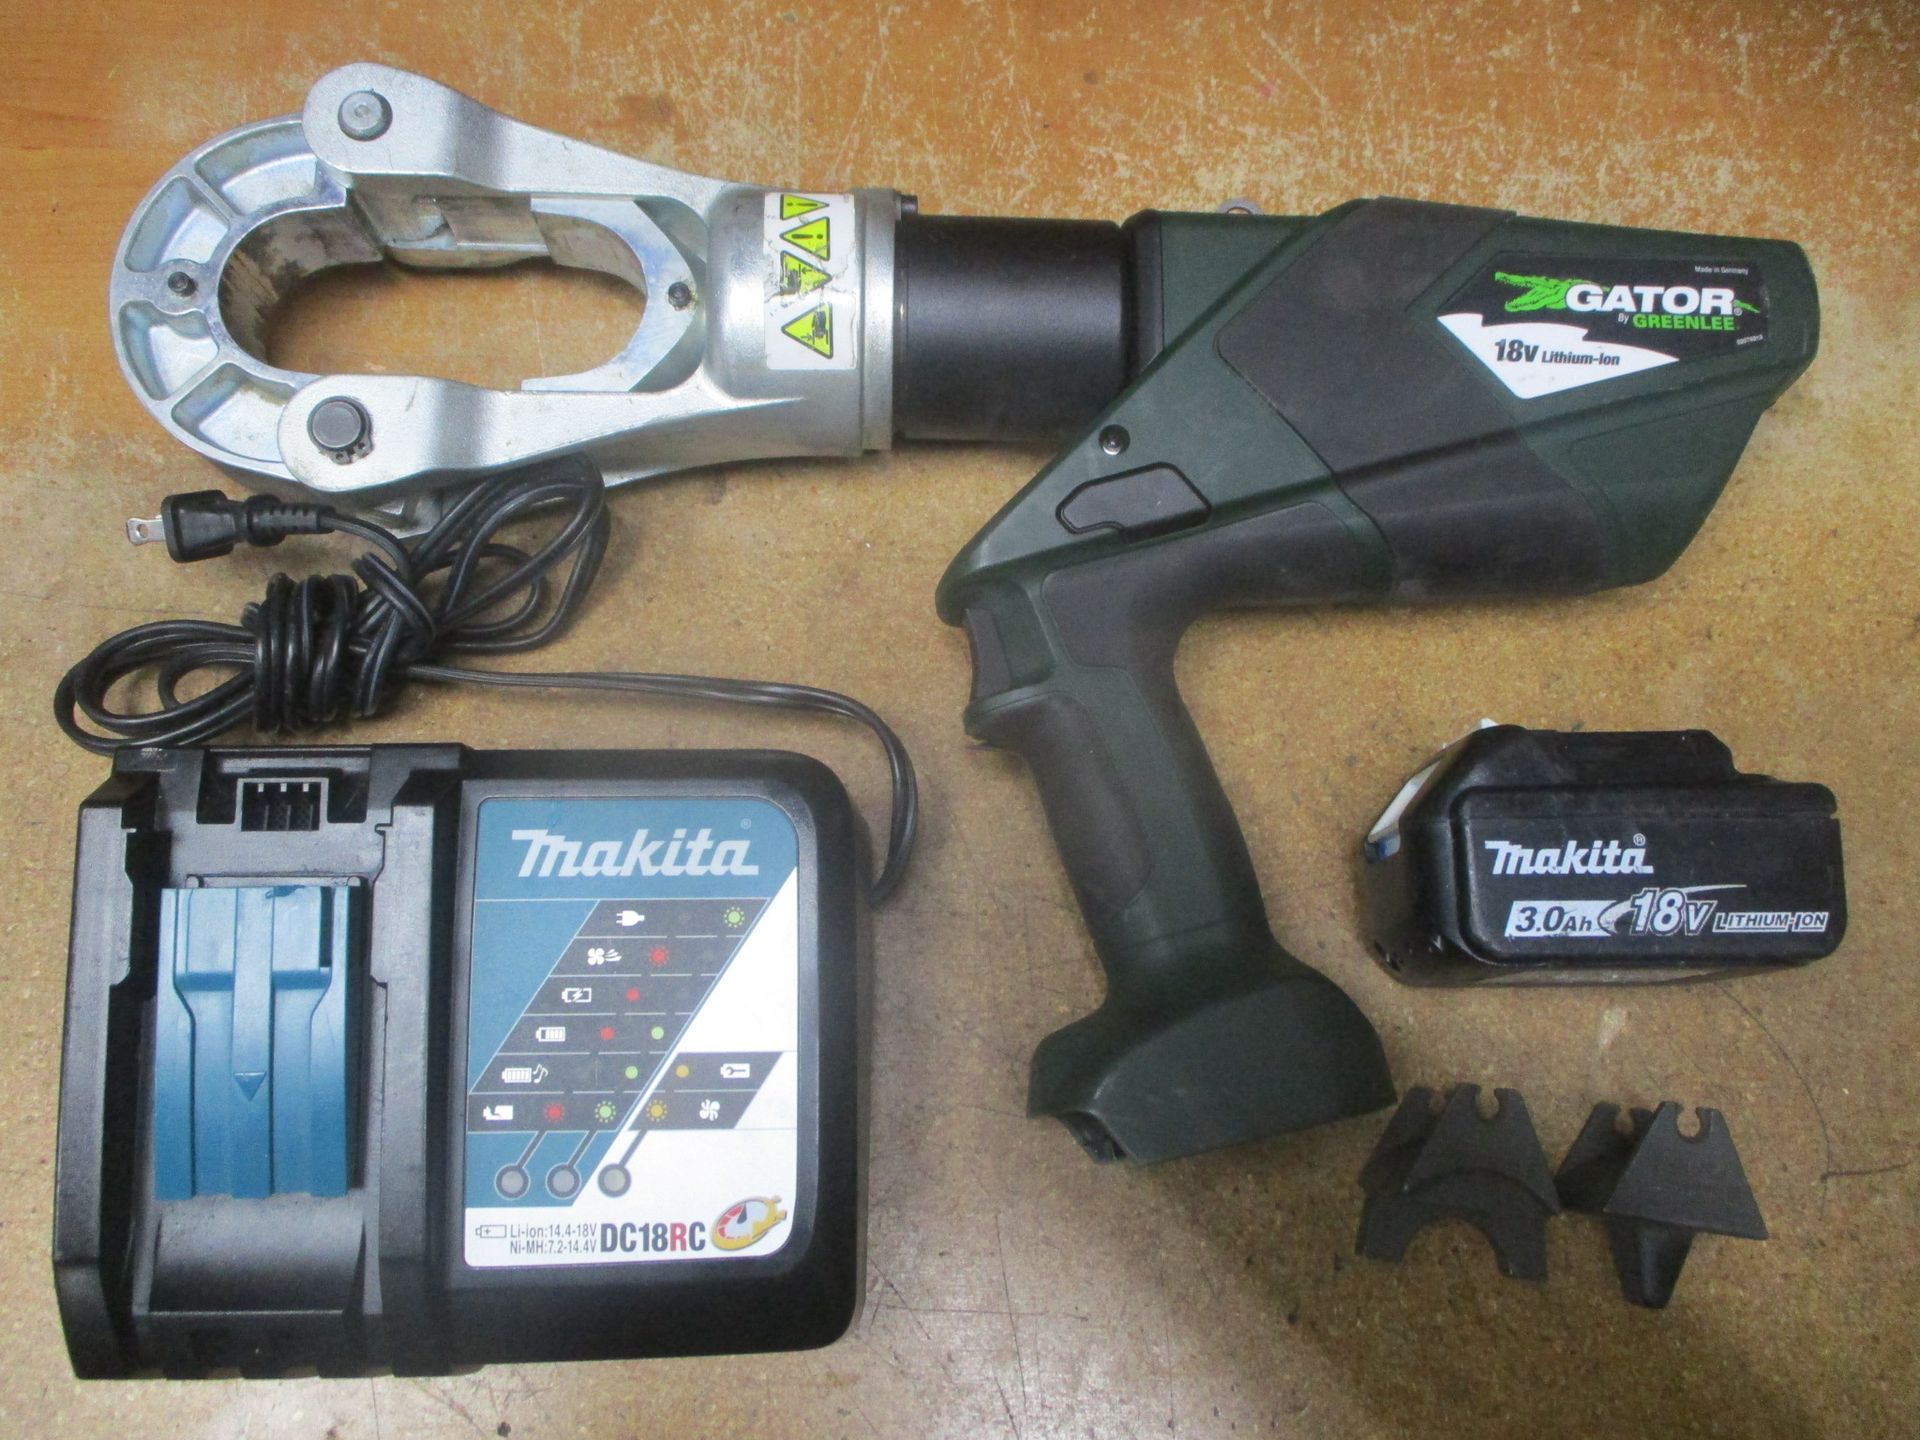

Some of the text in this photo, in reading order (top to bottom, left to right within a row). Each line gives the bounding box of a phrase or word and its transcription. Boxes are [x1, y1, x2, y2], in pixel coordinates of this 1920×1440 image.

[1565, 284, 1735, 315] GATOR
[1618, 313, 1735, 331] By GREENLEE
[512, 828, 759, 877] Makita
[1485, 840, 1654, 874] Makita
[1514, 905, 1592, 934] 3.0Ah
[1713, 912, 1829, 933] LITHIUM-ION
[600, 1222, 706, 1252] DC18RC
